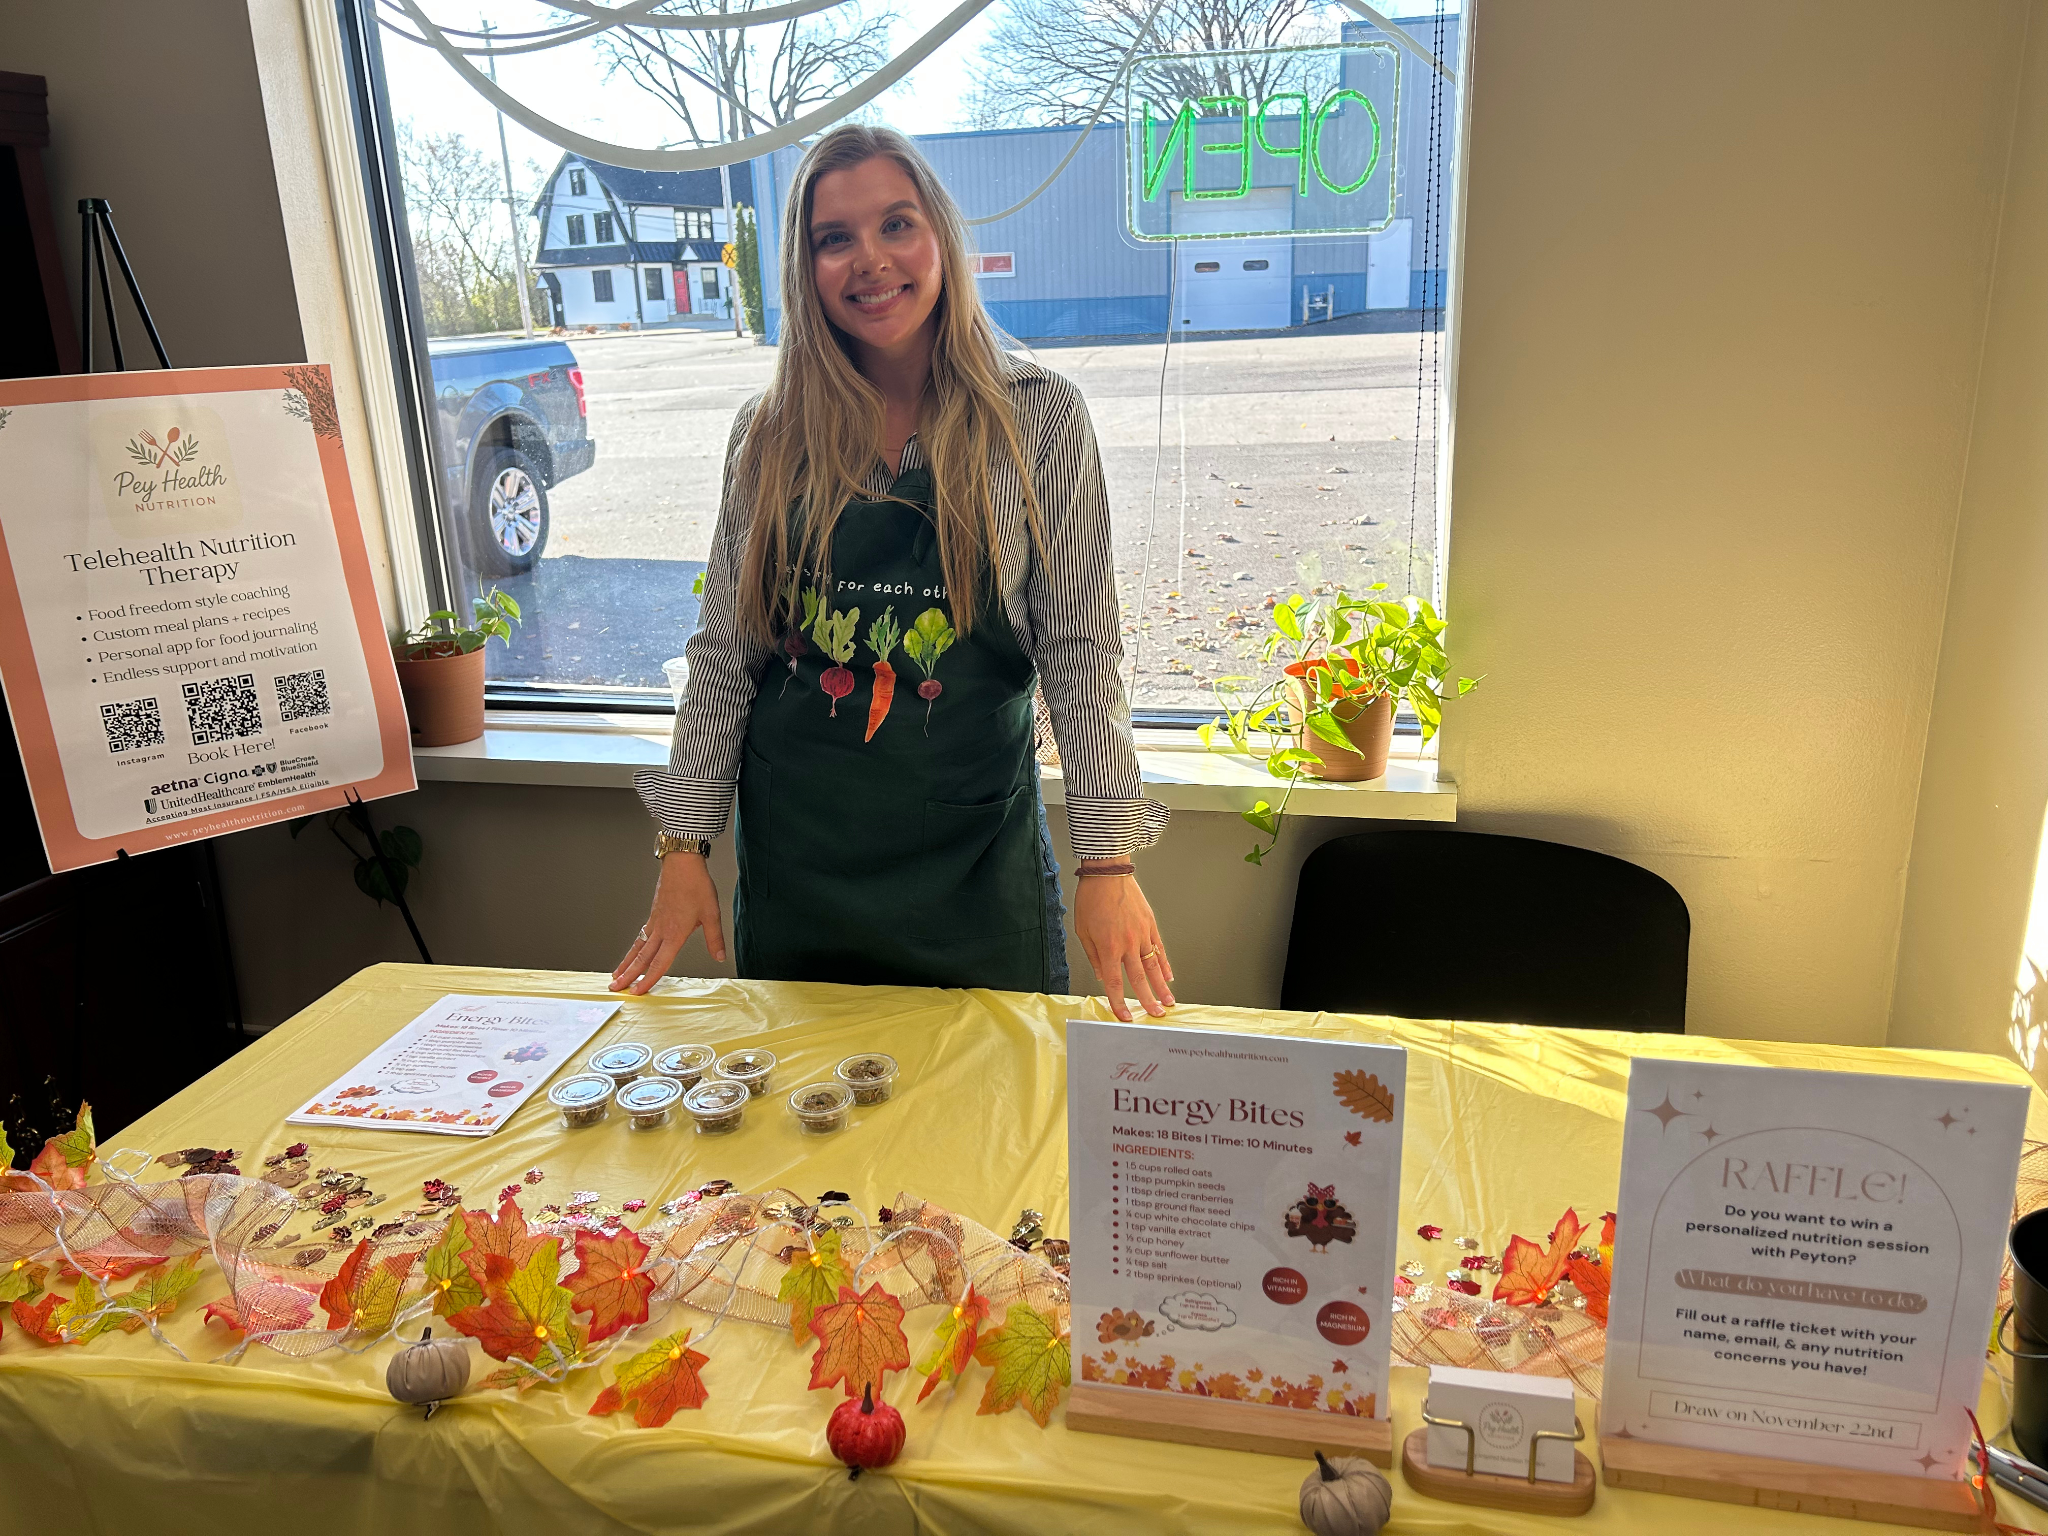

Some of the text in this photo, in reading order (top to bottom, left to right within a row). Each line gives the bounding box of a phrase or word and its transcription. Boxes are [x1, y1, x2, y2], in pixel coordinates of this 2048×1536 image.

[114, 465, 227, 502] Pey Health
[135, 497, 216, 512] NUTRITION
[64, 532, 297, 572] Telehealth Nutrition
[140, 562, 239, 586] Therapy
[874, 582, 913, 595] each
[923, 585, 948, 599] oth
[88, 585, 290, 621] Food freedom style coaching
[94, 625, 150, 642] Custom
[154, 619, 188, 634] meal
[193, 614, 229, 632] plans
[243, 605, 291, 621] recipes
[98, 621, 318, 662] Personal app for food journaling
[103, 641, 317, 683] Endless support and motivation
[289, 723, 329, 734] Facebook
[117, 754, 165, 766] Instagram
[188, 738, 276, 764] Book Here!
[280, 755, 315, 766] BlueCross
[281, 760, 318, 772] BlueShield
[151, 768, 248, 795] aetna Cigna
[160, 771, 316, 810] UnitedHealthcare EmblemHealth
[146, 810, 188, 824] Accepting
[191, 805, 211, 814] Most
[261, 786, 297, 798] FSA/HSA
[300, 779, 330, 790] Eligible
[165, 804, 305, 841] www.peyhealthnutrition.com
[446, 1013, 508, 1025] Energy
[1169, 1048, 1289, 1063] www.peyhealthnutrition.com
[1110, 1062, 1158, 1082] Fall
[1113, 1088, 1304, 1128] Energy Bites
[1112, 1126, 1154, 1138] Makes:
[1157, 1130, 1168, 1139] 18
[1172, 1131, 1201, 1143] Bites
[1210, 1134, 1243, 1146] Time:
[1248, 1138, 1260, 1148] 10
[1263, 1140, 1313, 1154] Minutes
[1112, 1143, 1194, 1159] INGREDIENTS:
[1126, 1161, 1212, 1178] 1.5 cups rolled oats
[1131, 1174, 1152, 1184] tbsp
[1155, 1178, 1195, 1188] pumpkin
[1198, 1182, 1225, 1191] seeds
[1722, 1157, 1906, 1203] RAFFLE!
[1131, 1186, 1152, 1196] tbsp
[1155, 1189, 1178, 1198] dried
[1181, 1193, 1233, 1204] cranberries
[1131, 1199, 1152, 1209] tbsp
[1155, 1202, 1187, 1211] ground
[1189, 1204, 1205, 1213] flax
[1208, 1208, 1230, 1216] seed
[1134, 1212, 1151, 1221] cup
[1154, 1213, 1179, 1223] white
[1182, 1216, 1227, 1228] chocolate
[1230, 1221, 1255, 1232] chips
[1725, 1205, 1893, 1232] Do you want to win a
[1131, 1223, 1145, 1232] tsp
[1148, 1225, 1176, 1235] vanilla
[1179, 1229, 1211, 1238] extract
[1686, 1221, 1929, 1254] personalized nutrition session
[1136, 1236, 1153, 1244] cup
[1156, 1237, 1184, 1248] honey
[1134, 1248, 1152, 1256] cup
[1155, 1250, 1198, 1260] sunflower
[1200, 1254, 1229, 1264] butter
[1134, 1259, 1149, 1268] tsp
[1152, 1260, 1167, 1269] salt
[1751, 1246, 1856, 1265] with Peyton?
[1134, 1271, 1154, 1280] tbsp
[1157, 1274, 1194, 1284] sprinkes
[1197, 1276, 1241, 1290] (optional)
[1267, 1285, 1295, 1293] VITAMIN
[1679, 1269, 1927, 1310] What do you have to do?
[1321, 1321, 1365, 1331] MAGNESIUM
[1676, 1309, 1696, 1321] Fill
[1701, 1314, 1726, 1324] out
[1744, 1316, 1785, 1330] raffle
[1790, 1323, 1836, 1337] ticket
[1841, 1328, 1874, 1341] with
[1880, 1334, 1916, 1345] your
[1683, 1328, 1903, 1362] name, email, & any nutrition
[1714, 1350, 1867, 1376] concerns you have!
[1674, 1401, 1894, 1440] Draw on November 22nd
